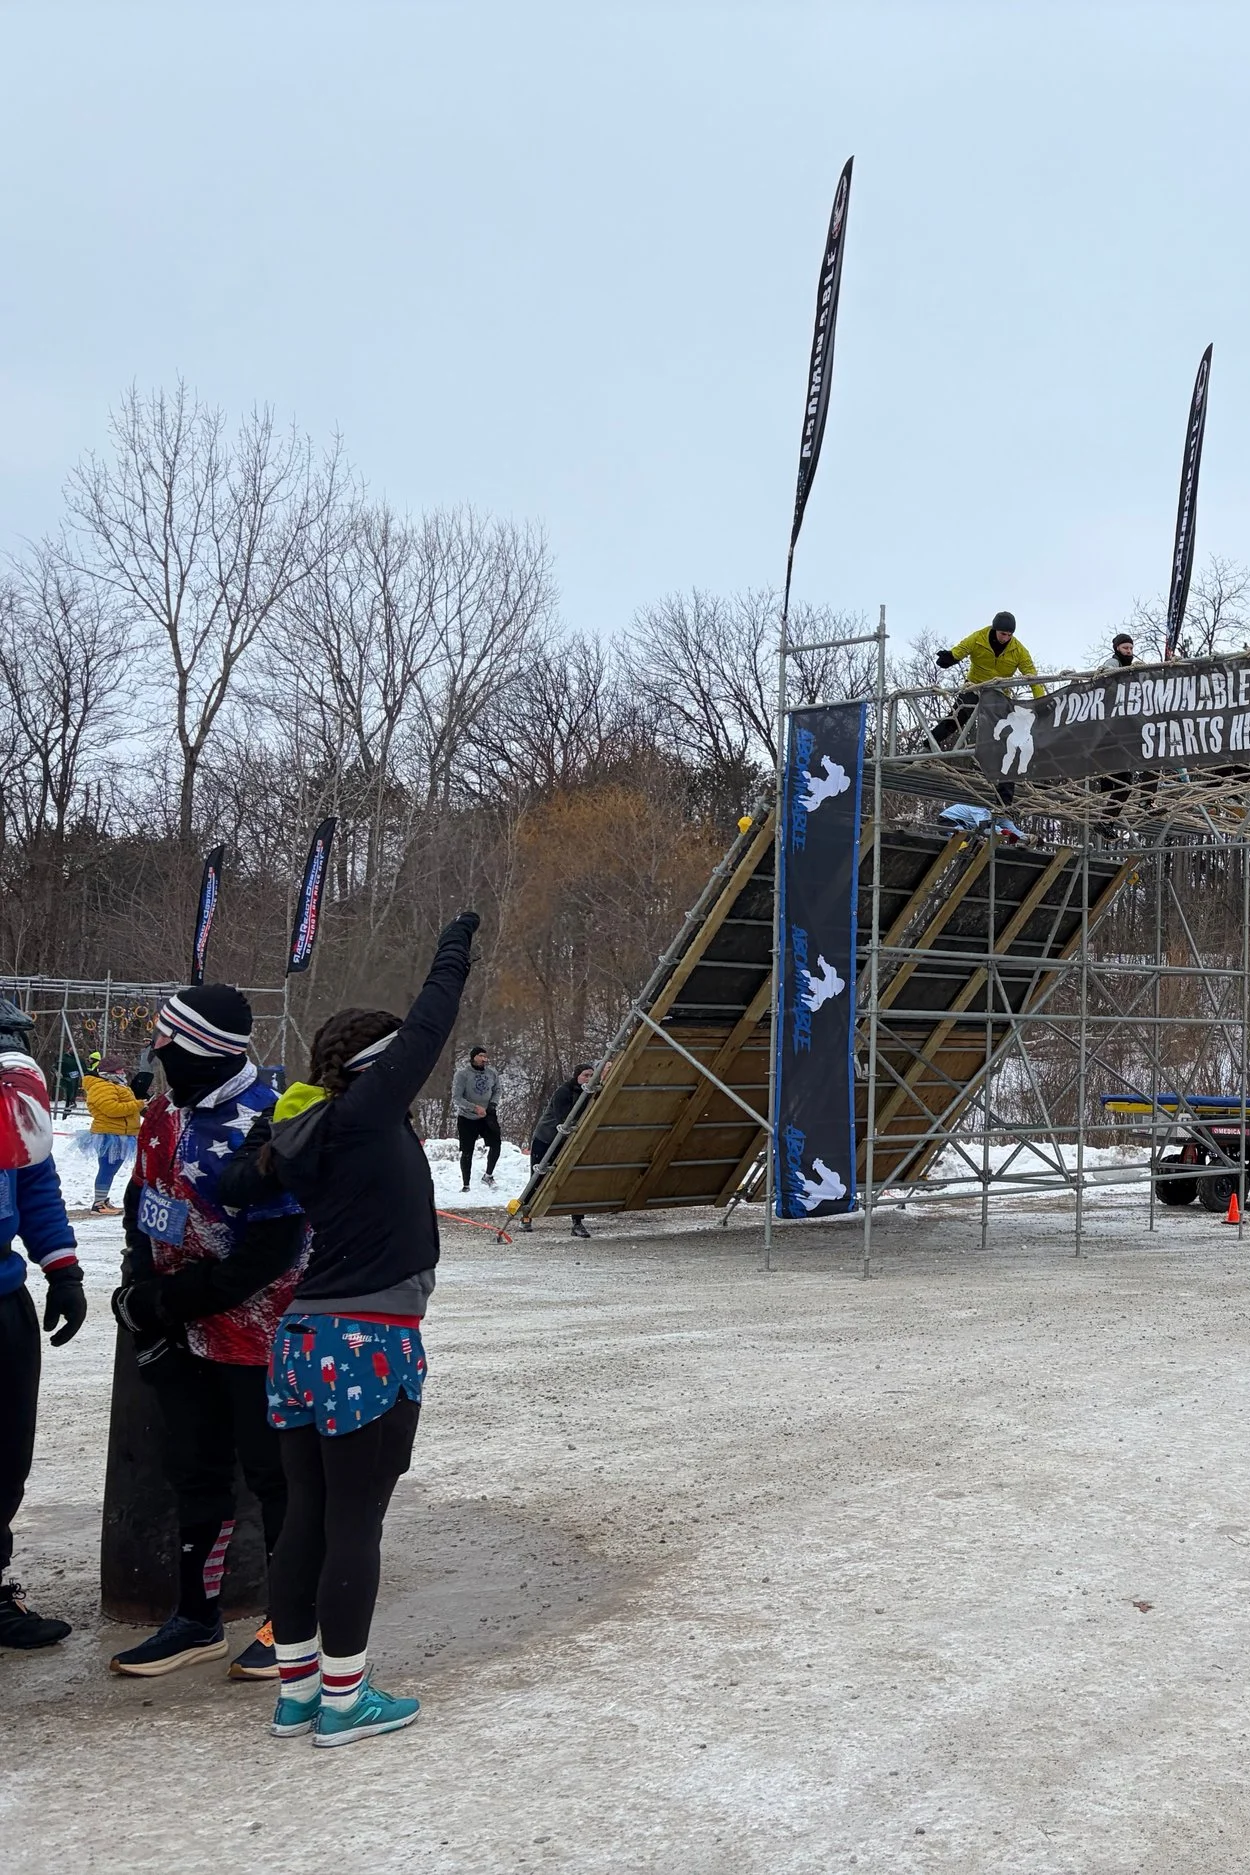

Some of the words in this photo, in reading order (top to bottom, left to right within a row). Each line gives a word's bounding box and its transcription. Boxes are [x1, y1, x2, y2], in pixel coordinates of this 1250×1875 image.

[1053, 687, 1105, 728] YOUR
[1110, 668, 1250, 718] ABOMINABLE
[1141, 716, 1224, 759] STARTS
[300, 897, 311, 932] READY
[1218, 1127, 1242, 1136] MEDICA
[141, 1199, 169, 1232] 538
